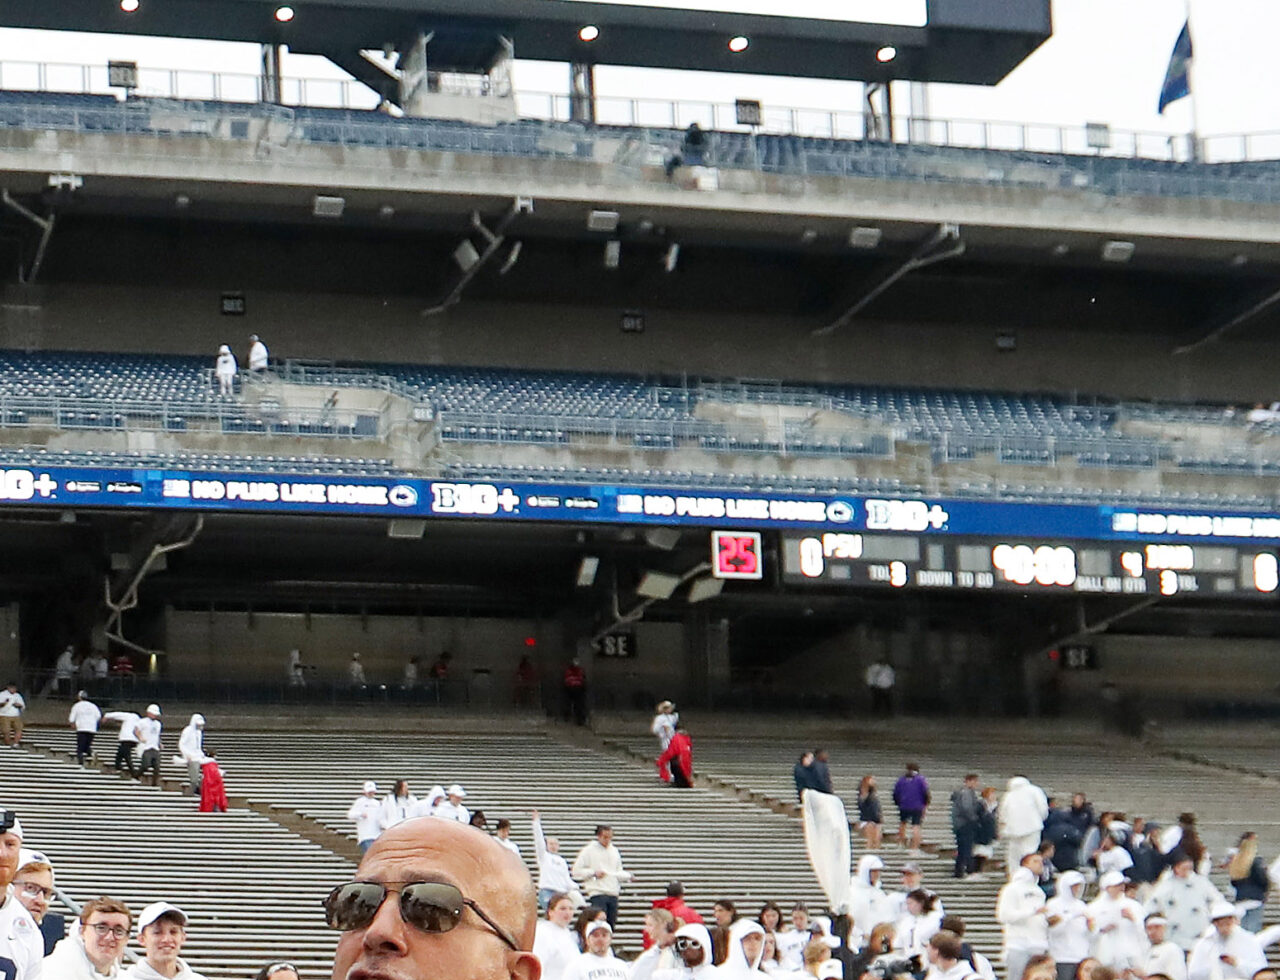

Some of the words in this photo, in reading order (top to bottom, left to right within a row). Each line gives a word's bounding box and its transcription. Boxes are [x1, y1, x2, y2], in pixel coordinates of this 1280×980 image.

[192, 480, 225, 499] NO
[227, 481, 279, 502] PLUS
[280, 483, 327, 503] LIKE
[328, 485, 389, 505] HOME
[644, 496, 676, 515] NO
[677, 497, 726, 517] PLUS
[726, 499, 770, 519] LIKE
[770, 501, 826, 521] HOME
[719, 536, 757, 573] 25
[822, 534, 863, 558] PSU
[919, 572, 953, 585] DOWN
[960, 573, 973, 585] TO
[1076, 577, 1103, 590] BALL
[1106, 578, 1121, 591] ON
[605, 636, 628, 655] SE
